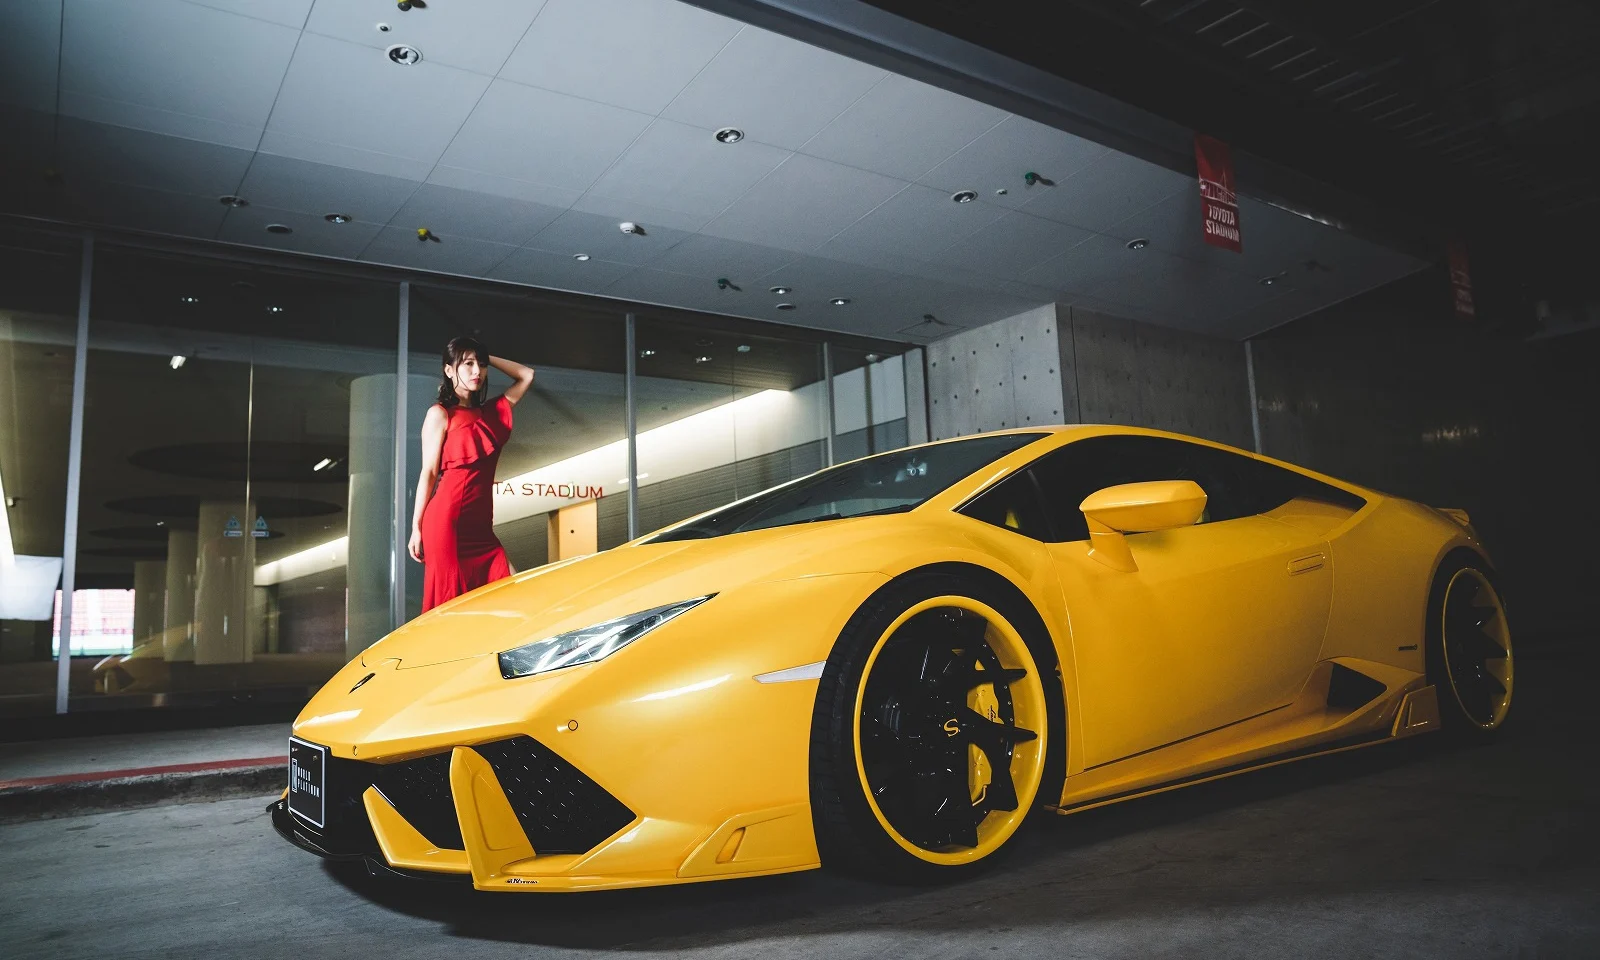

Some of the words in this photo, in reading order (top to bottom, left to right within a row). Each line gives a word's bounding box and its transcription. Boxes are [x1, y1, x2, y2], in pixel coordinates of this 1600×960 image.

[1208, 204, 1235, 226] TOYOTA
[1206, 220, 1239, 242] STADIUM
[522, 483, 603, 499] STADIUM
